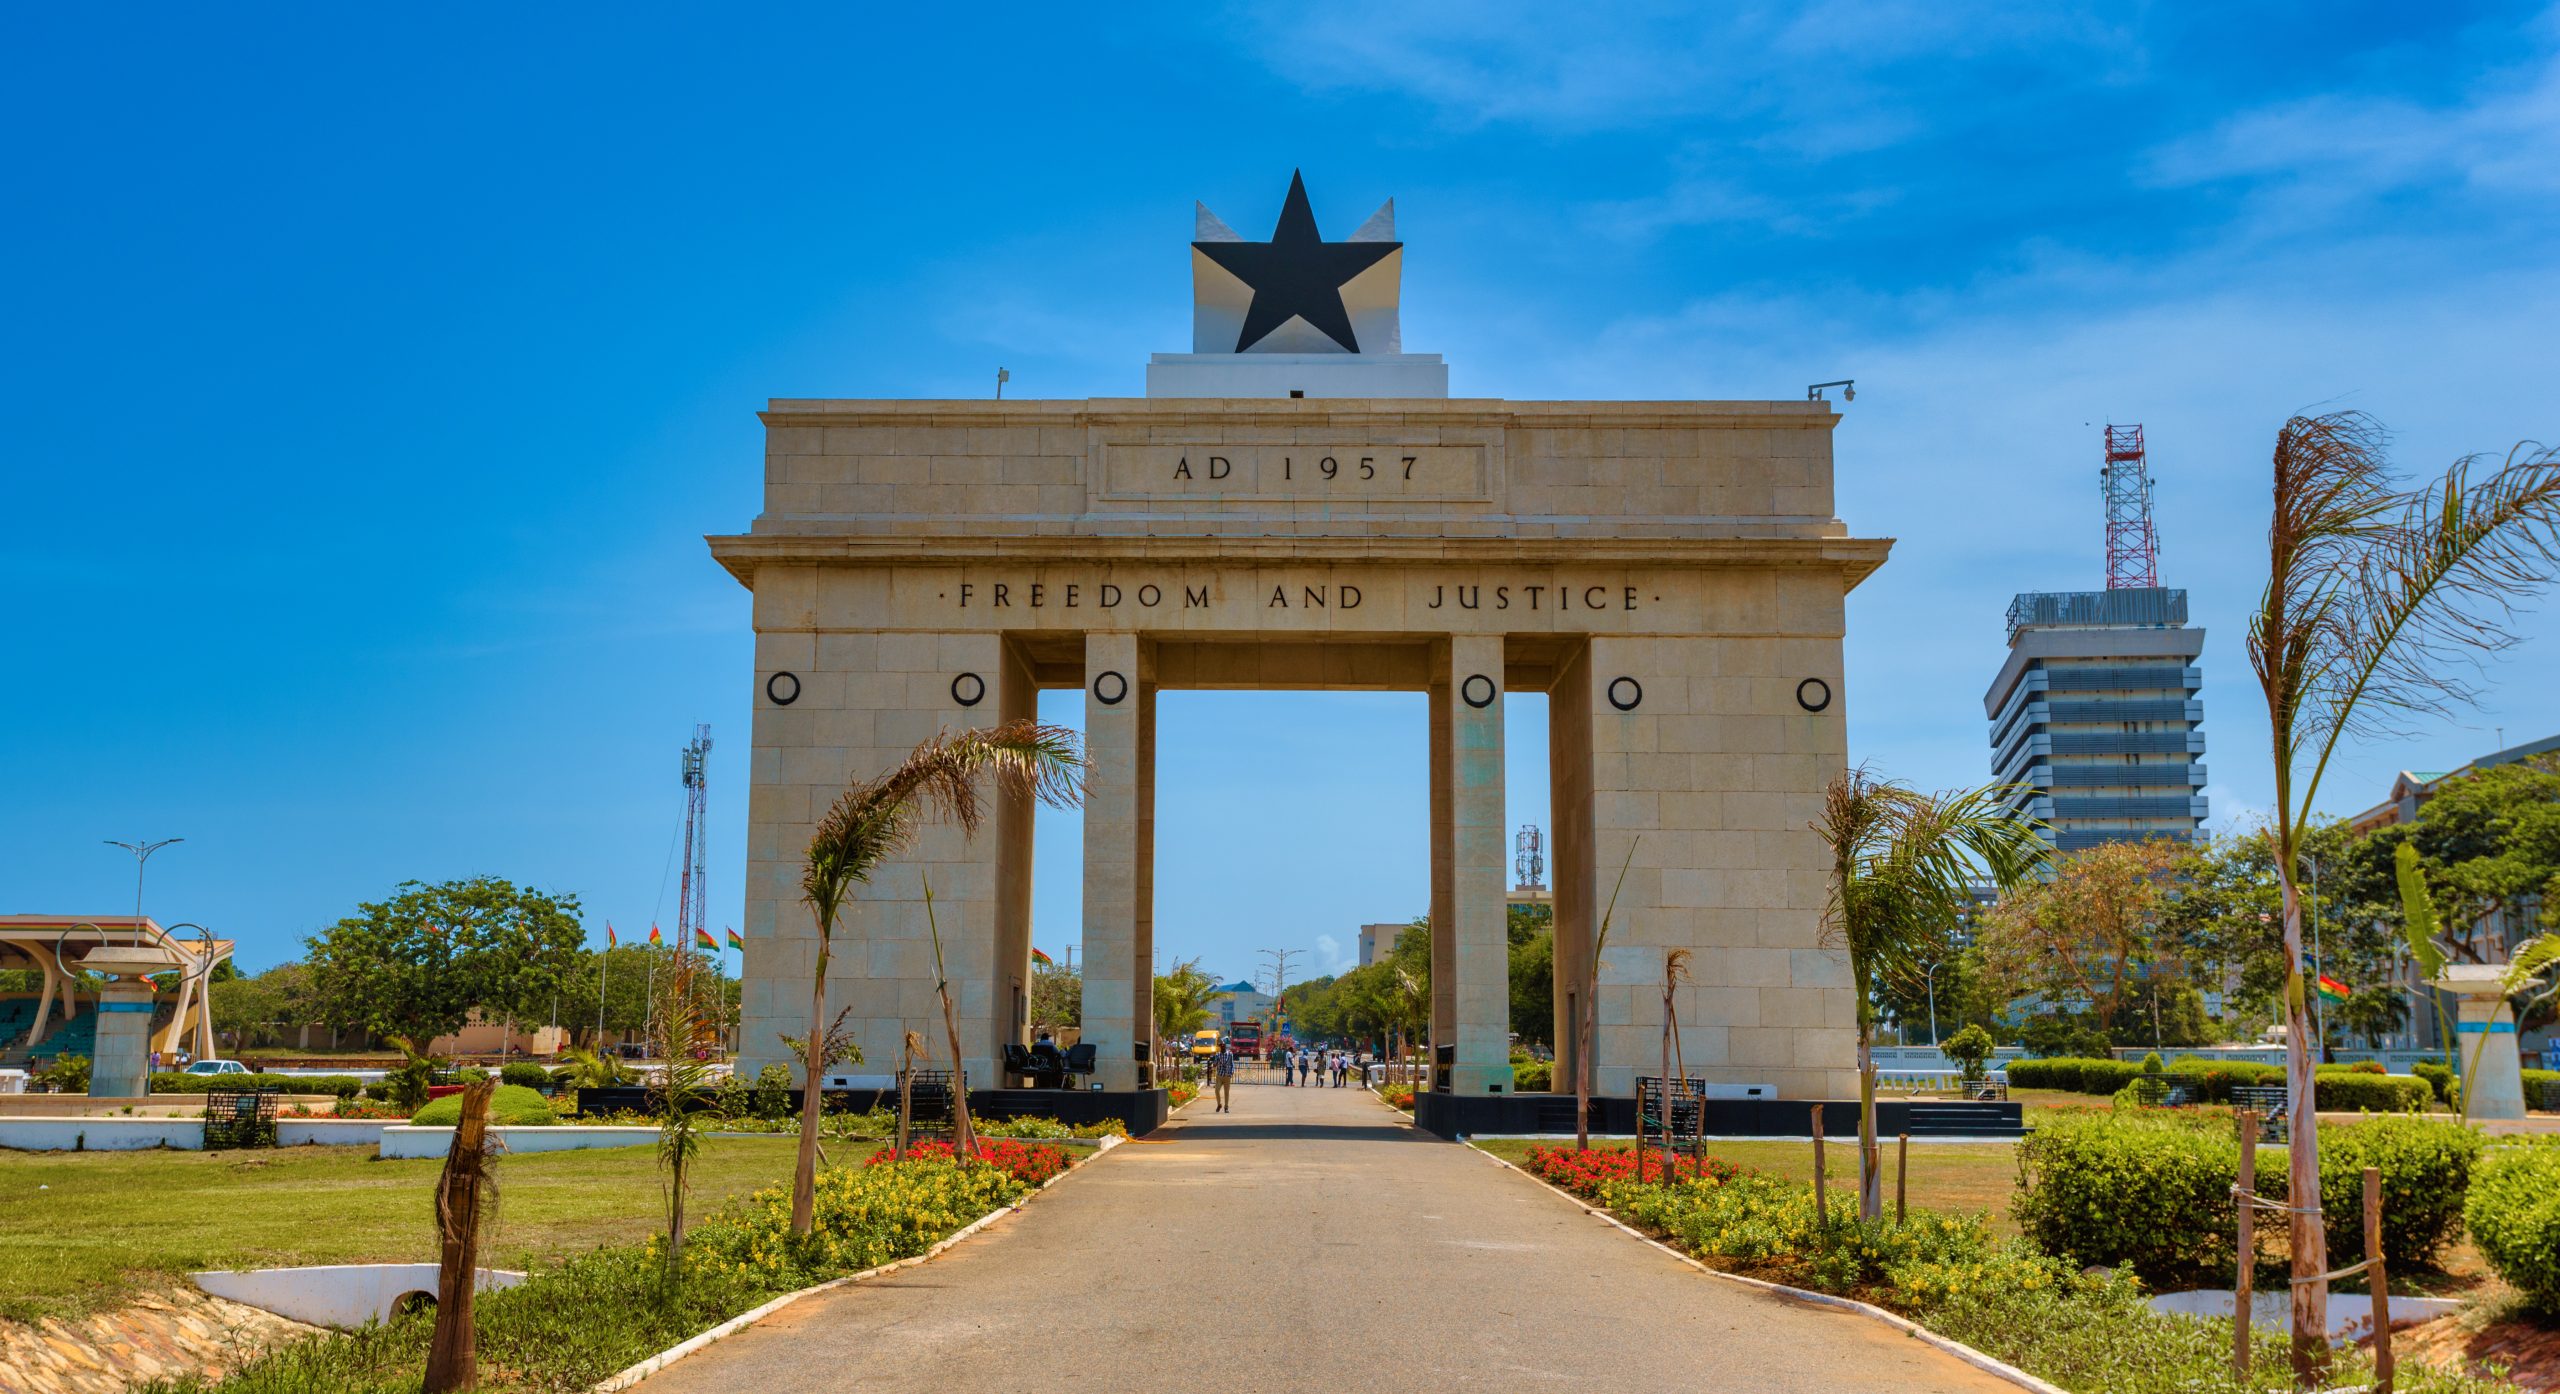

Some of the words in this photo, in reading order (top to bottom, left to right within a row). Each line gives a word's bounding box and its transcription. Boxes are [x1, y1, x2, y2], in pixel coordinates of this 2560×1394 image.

[1173, 456, 1231, 480] AD
[1284, 456, 1417, 480] 1957
[959, 583, 1209, 609] FREEDOM
[1269, 584, 1362, 609] AND
[1428, 585, 1638, 611] JUSTICE
